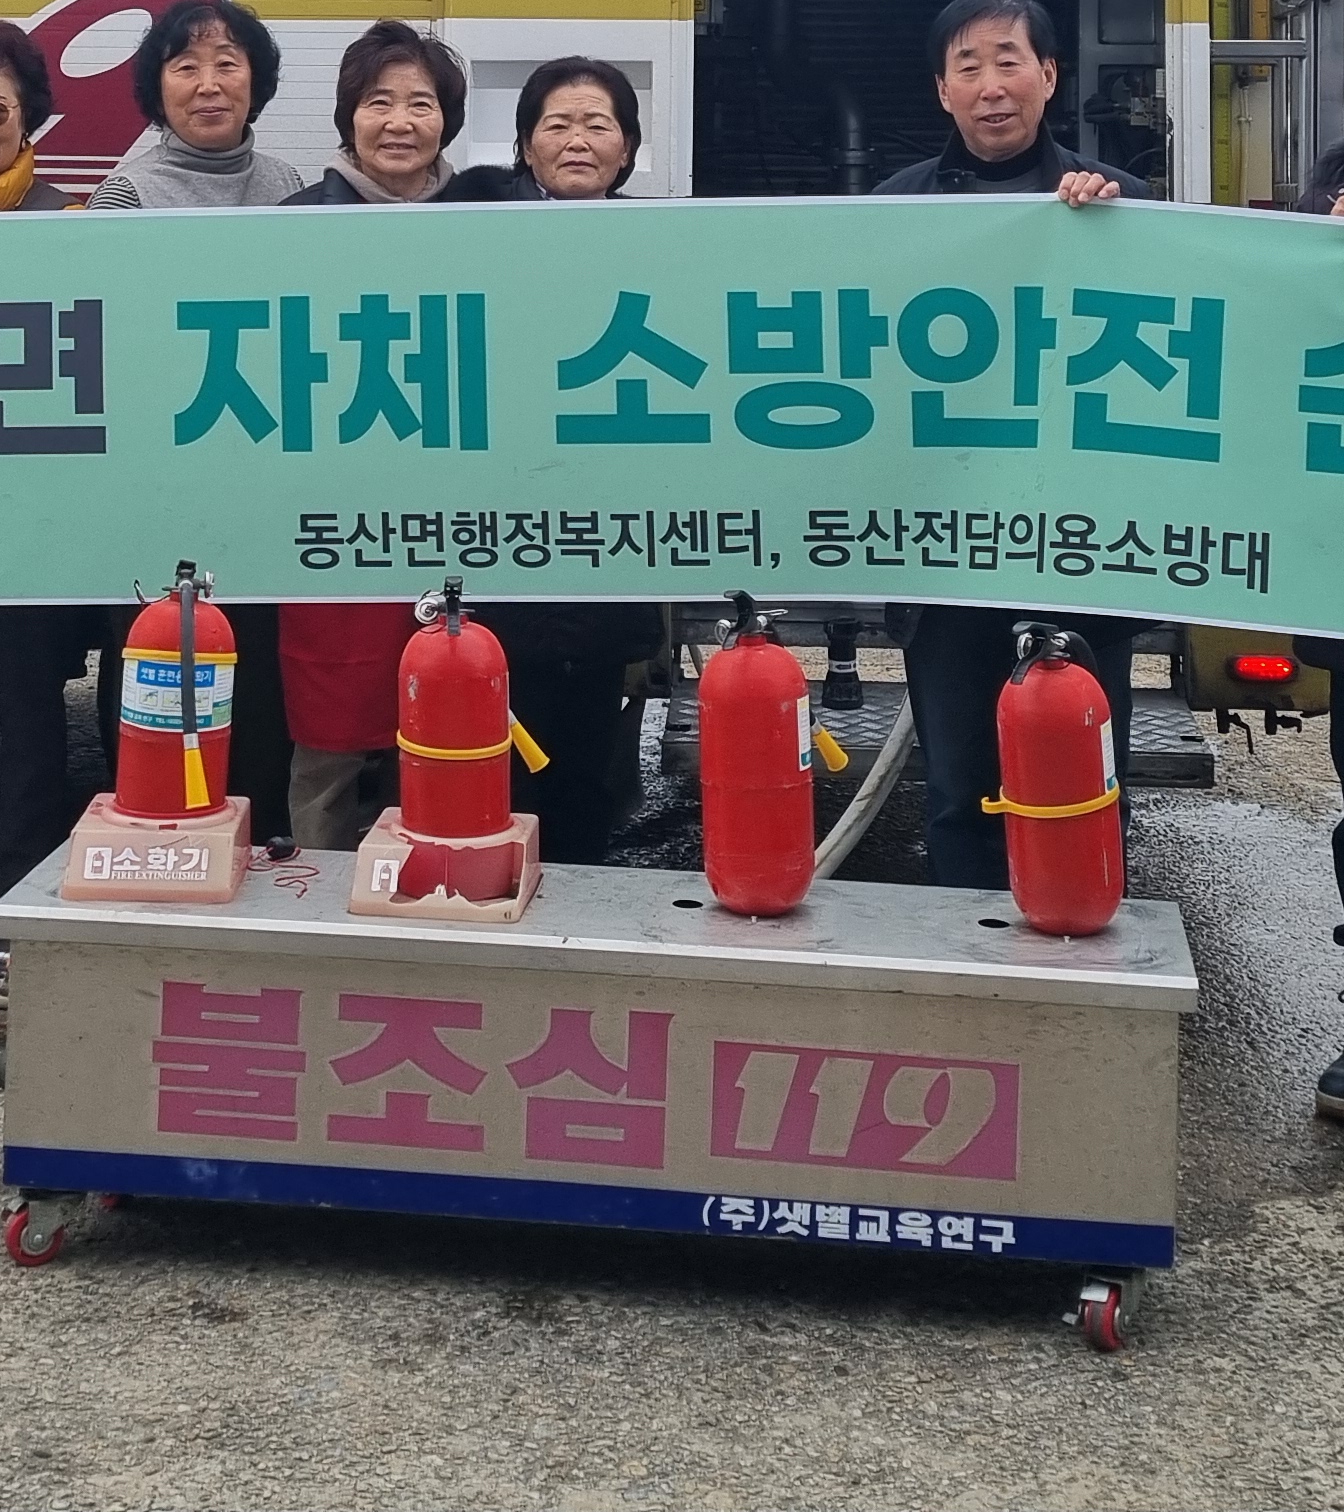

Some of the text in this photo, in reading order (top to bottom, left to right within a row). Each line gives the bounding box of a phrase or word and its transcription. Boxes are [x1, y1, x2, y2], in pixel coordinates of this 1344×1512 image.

[174, 292, 489, 453] 자체
[555, 285, 1226, 464] 소방안전
[294, 508, 1271, 595] 동산면행정복지센터, 동산전담의용소방대
[111, 870, 207, 881] FIRE EXTINGUISHER
[112, 846, 210, 871] 소화기
[150, 980, 997, 1171] 불조심 119
[702, 1195, 1017, 1254] (주)샛별교육연구
